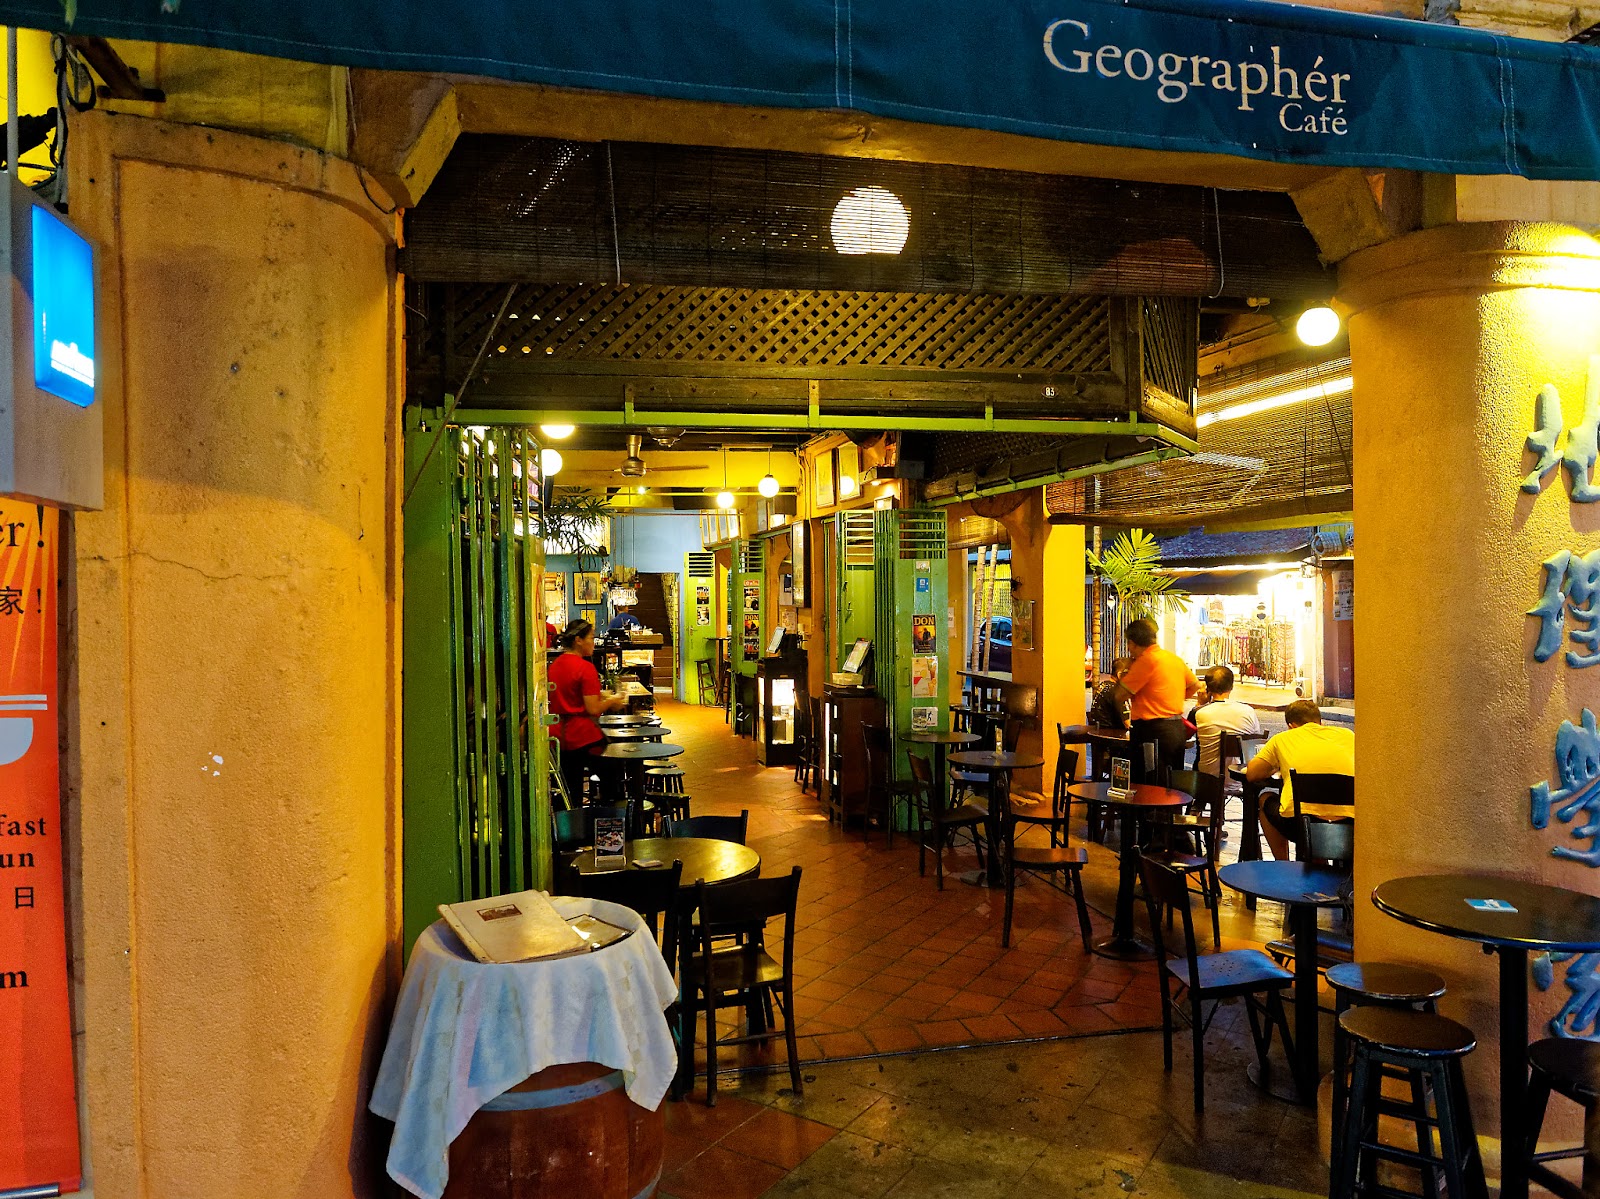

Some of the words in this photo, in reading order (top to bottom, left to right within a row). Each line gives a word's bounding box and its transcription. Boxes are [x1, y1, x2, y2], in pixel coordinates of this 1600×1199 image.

[1043, 19, 1350, 111] Geographér
[1279, 102, 1348, 136] Café
[914, 616, 935, 626] DON
[15, 886, 34, 909] 日
